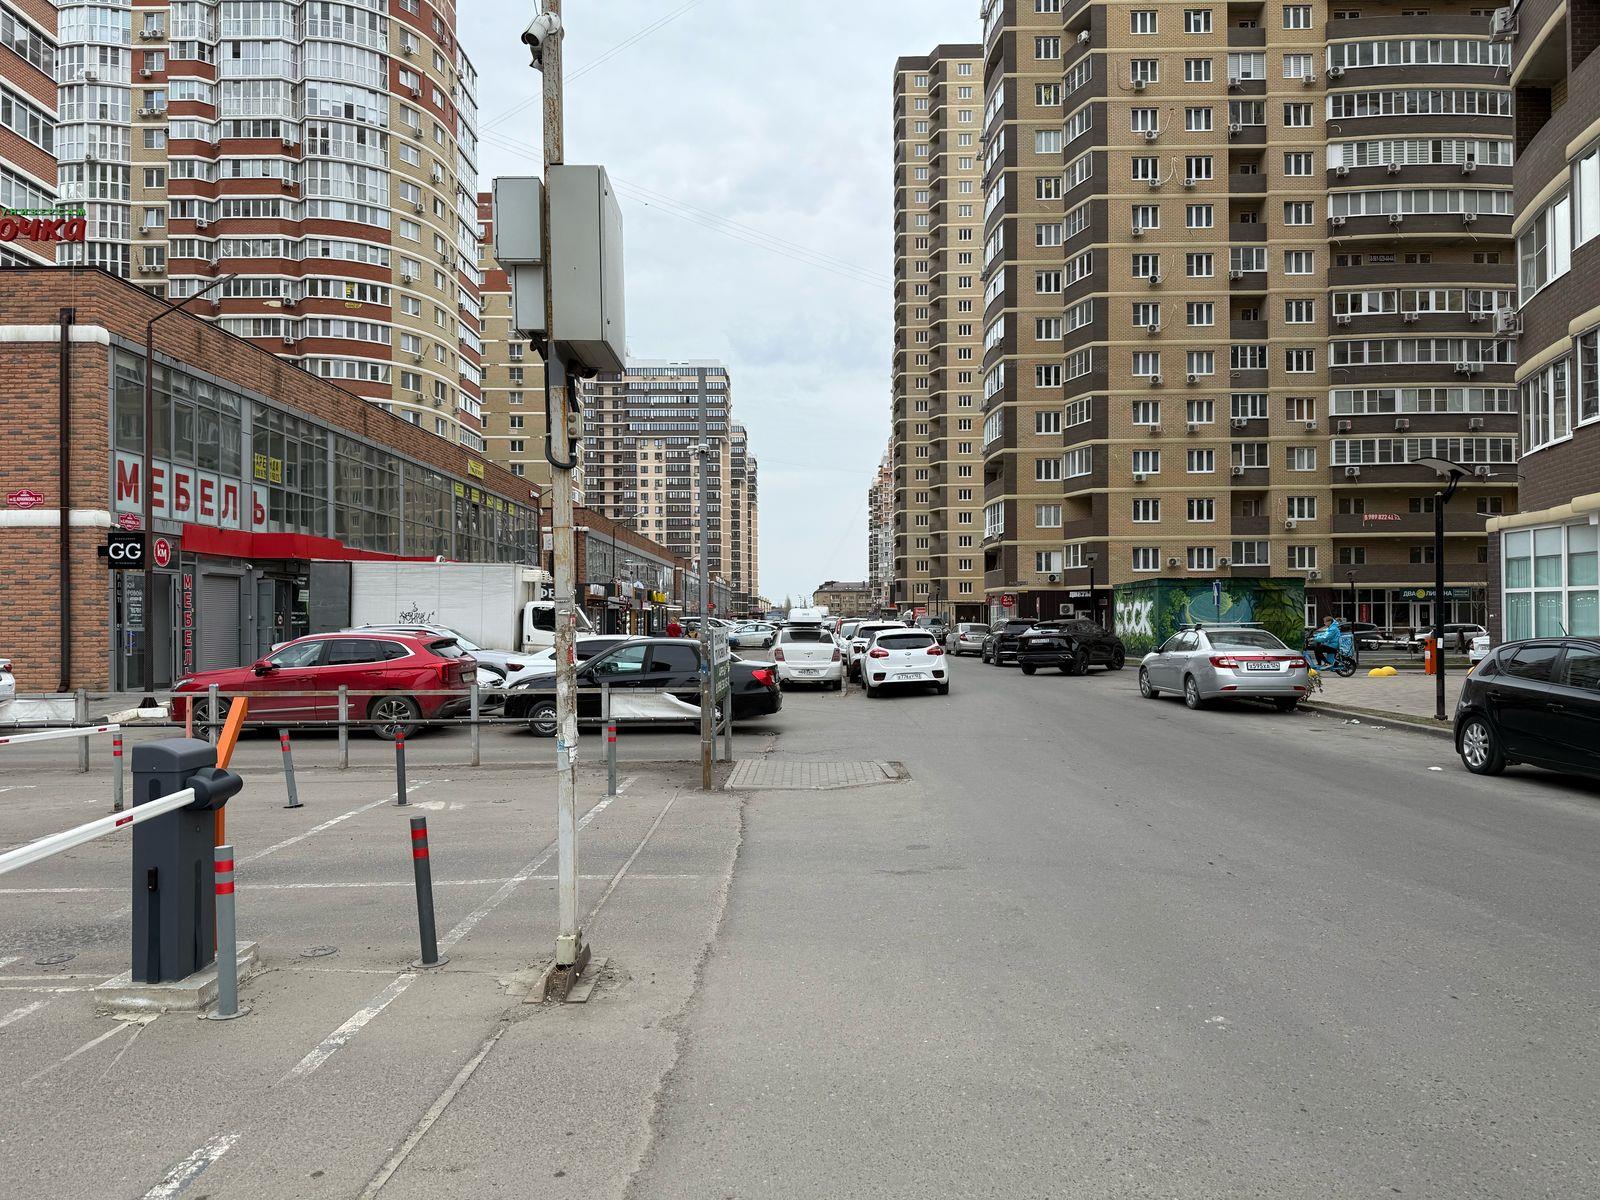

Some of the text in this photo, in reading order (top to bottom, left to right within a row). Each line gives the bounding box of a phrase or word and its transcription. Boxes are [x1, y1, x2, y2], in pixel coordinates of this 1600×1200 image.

[1, 207, 87, 217] УНИВЕРСАМ
[117, 459, 266, 526] МЕБЕЛЬ
[109, 543, 142, 560] GG
